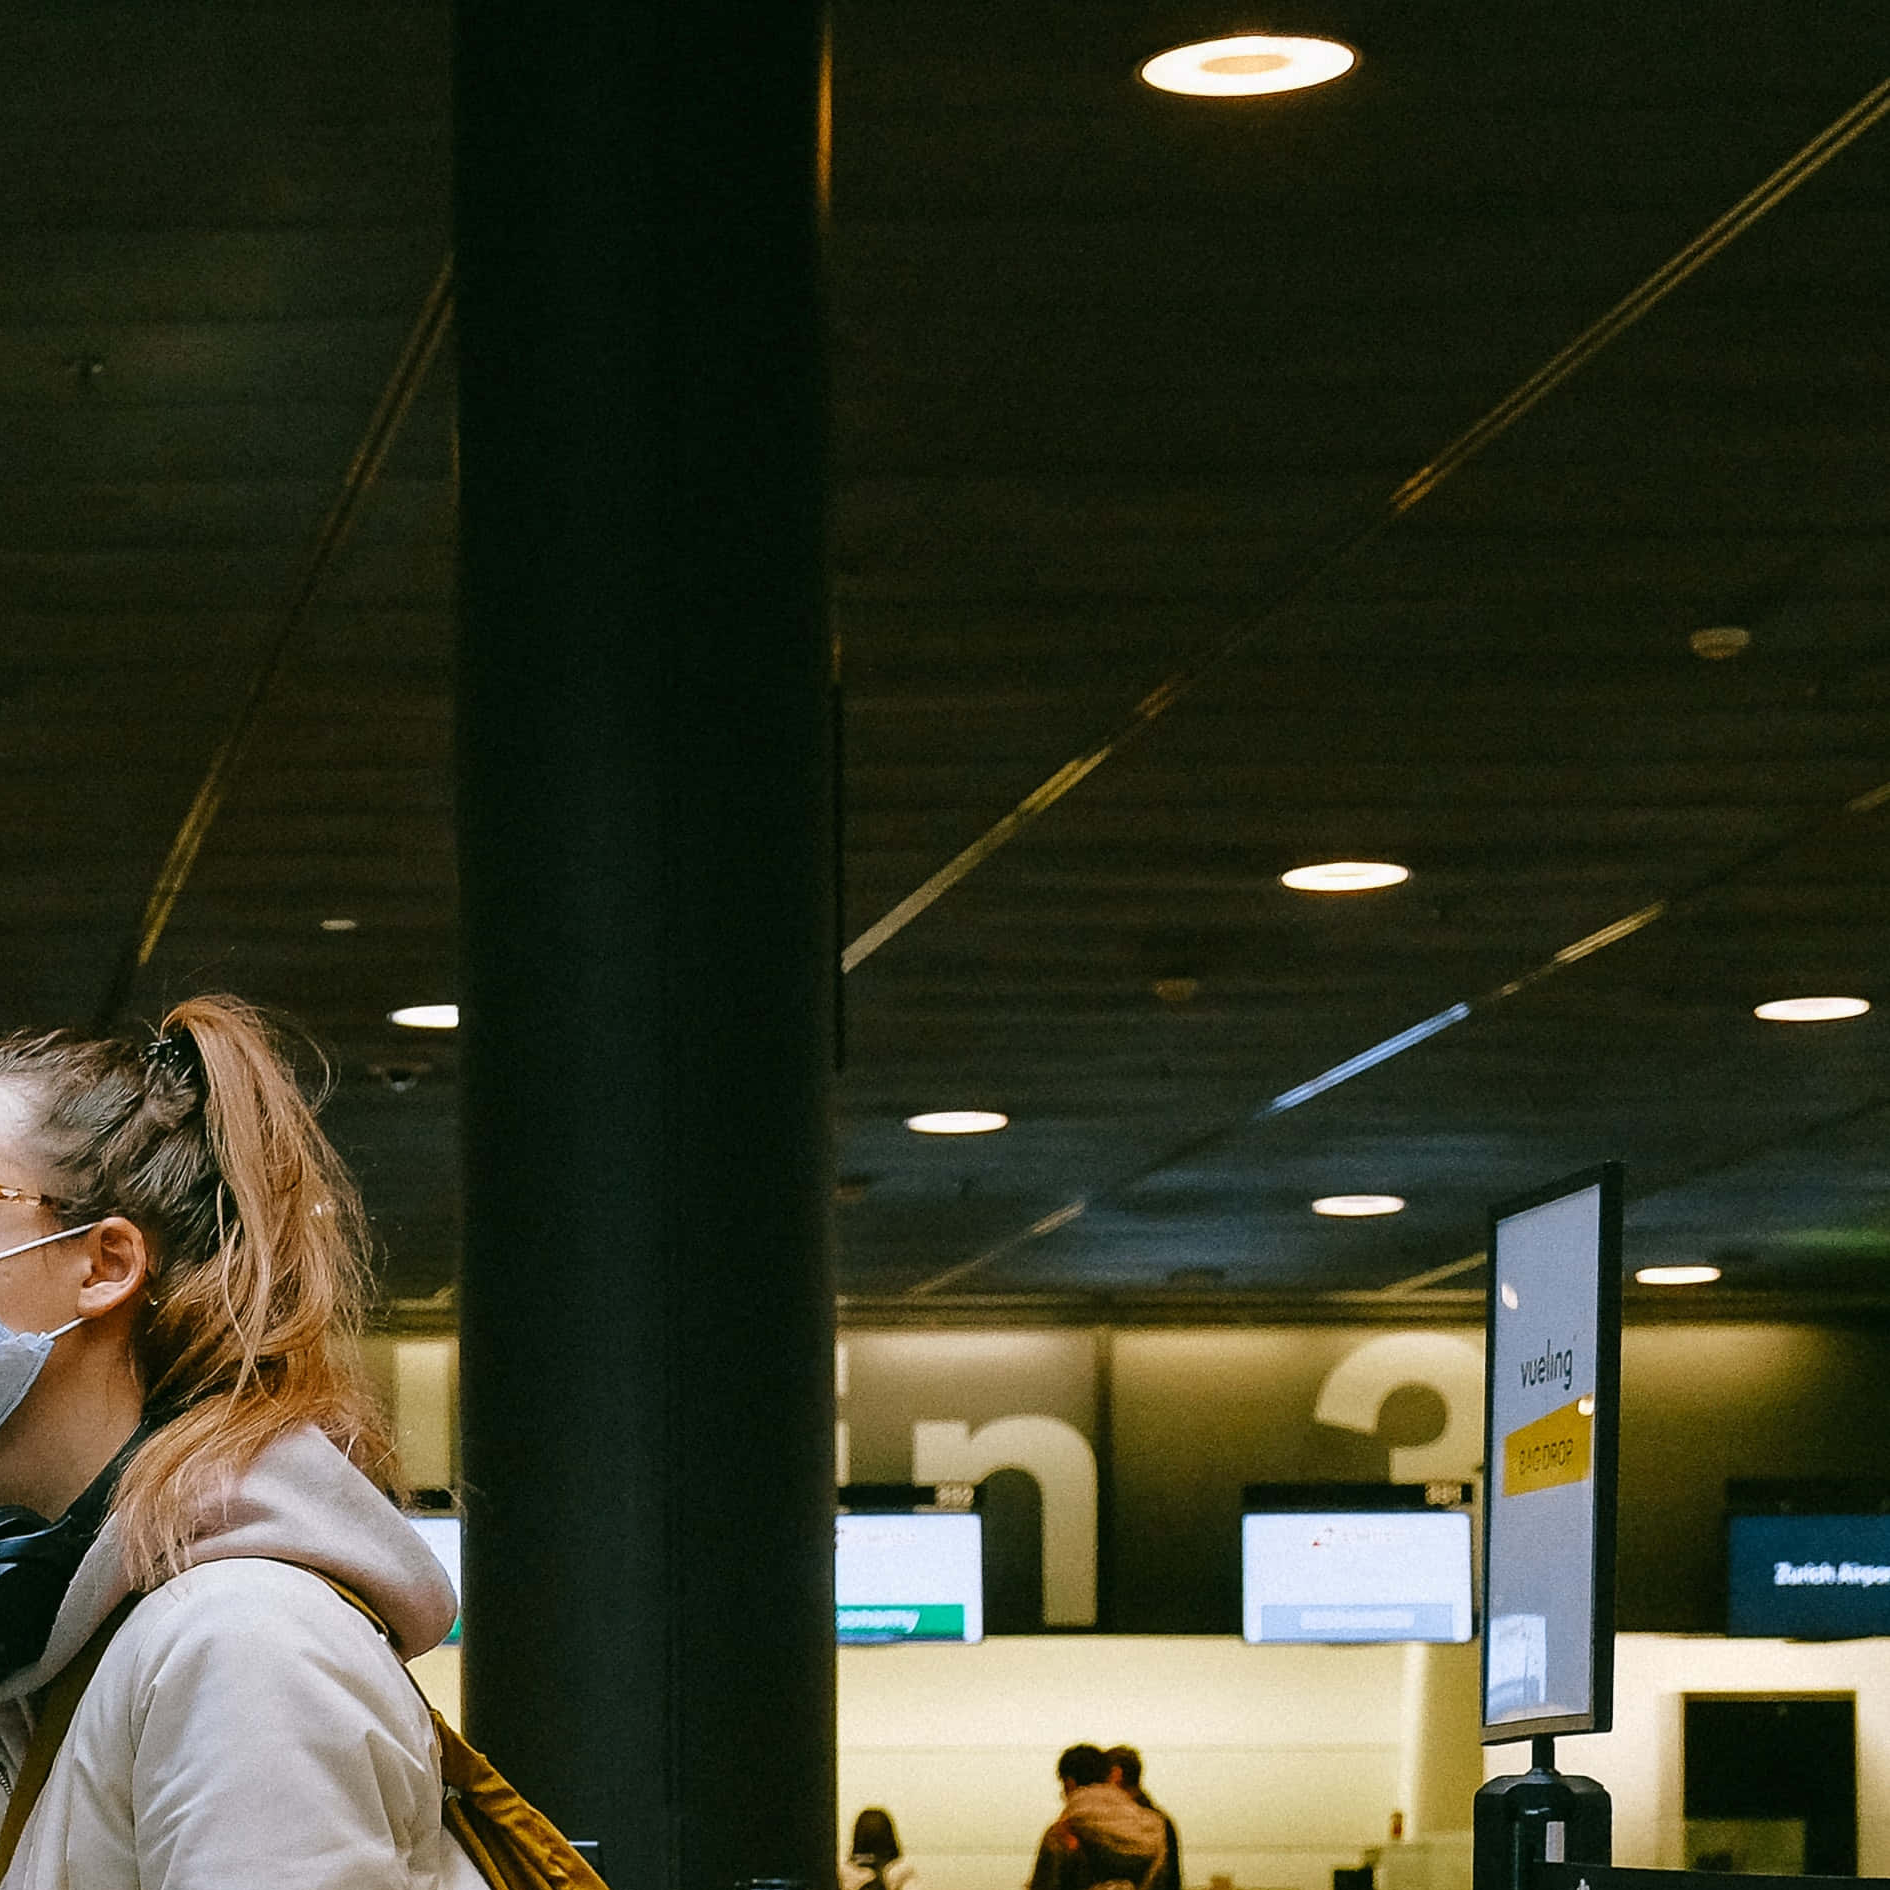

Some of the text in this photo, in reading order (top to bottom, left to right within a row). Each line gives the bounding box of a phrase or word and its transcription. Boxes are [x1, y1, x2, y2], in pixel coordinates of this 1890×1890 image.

[1520, 1338, 1573, 1391] vueling
[1518, 1437, 1574, 1475] BAG DROP
